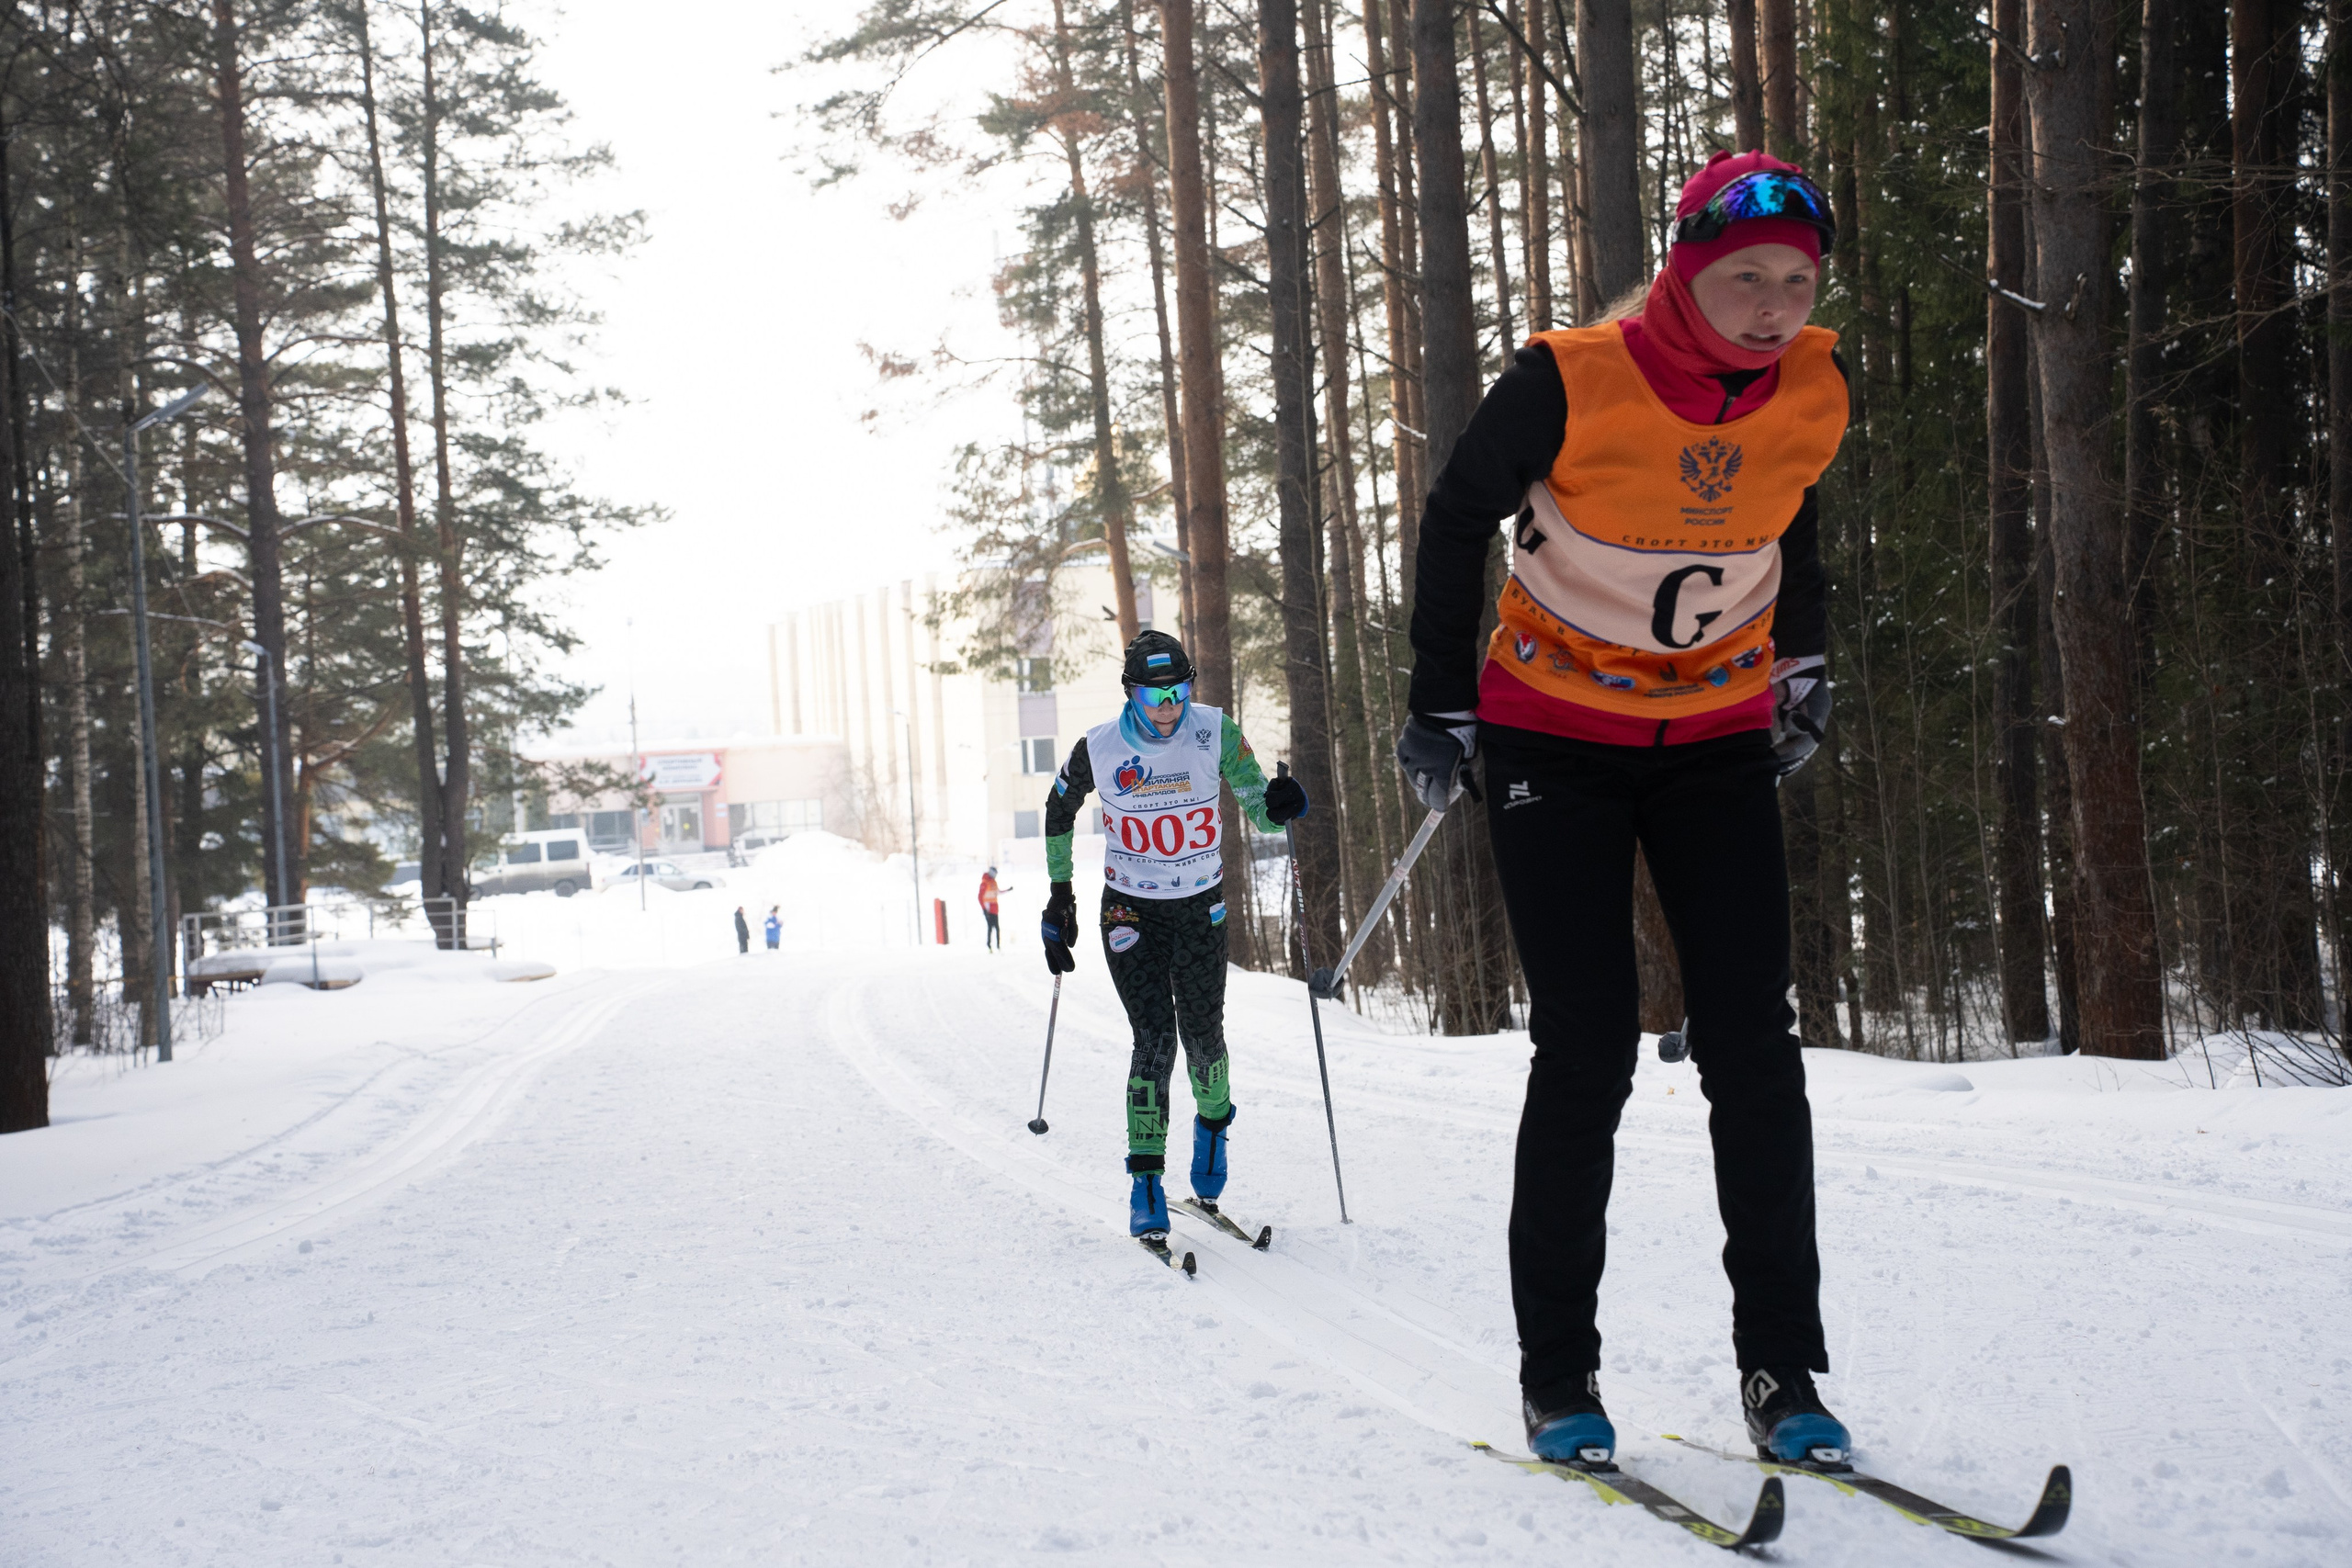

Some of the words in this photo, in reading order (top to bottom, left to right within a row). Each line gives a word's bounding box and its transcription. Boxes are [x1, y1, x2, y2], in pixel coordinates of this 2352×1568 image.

[1622, 535, 1688, 547] СПОРТ
[1700, 538, 1735, 548] ЭТО
[1651, 564, 1724, 649] G
[1145, 775, 1191, 787] ЗИМНЯЯ
[1133, 790, 1176, 798] ИНВАЛИДОВ
